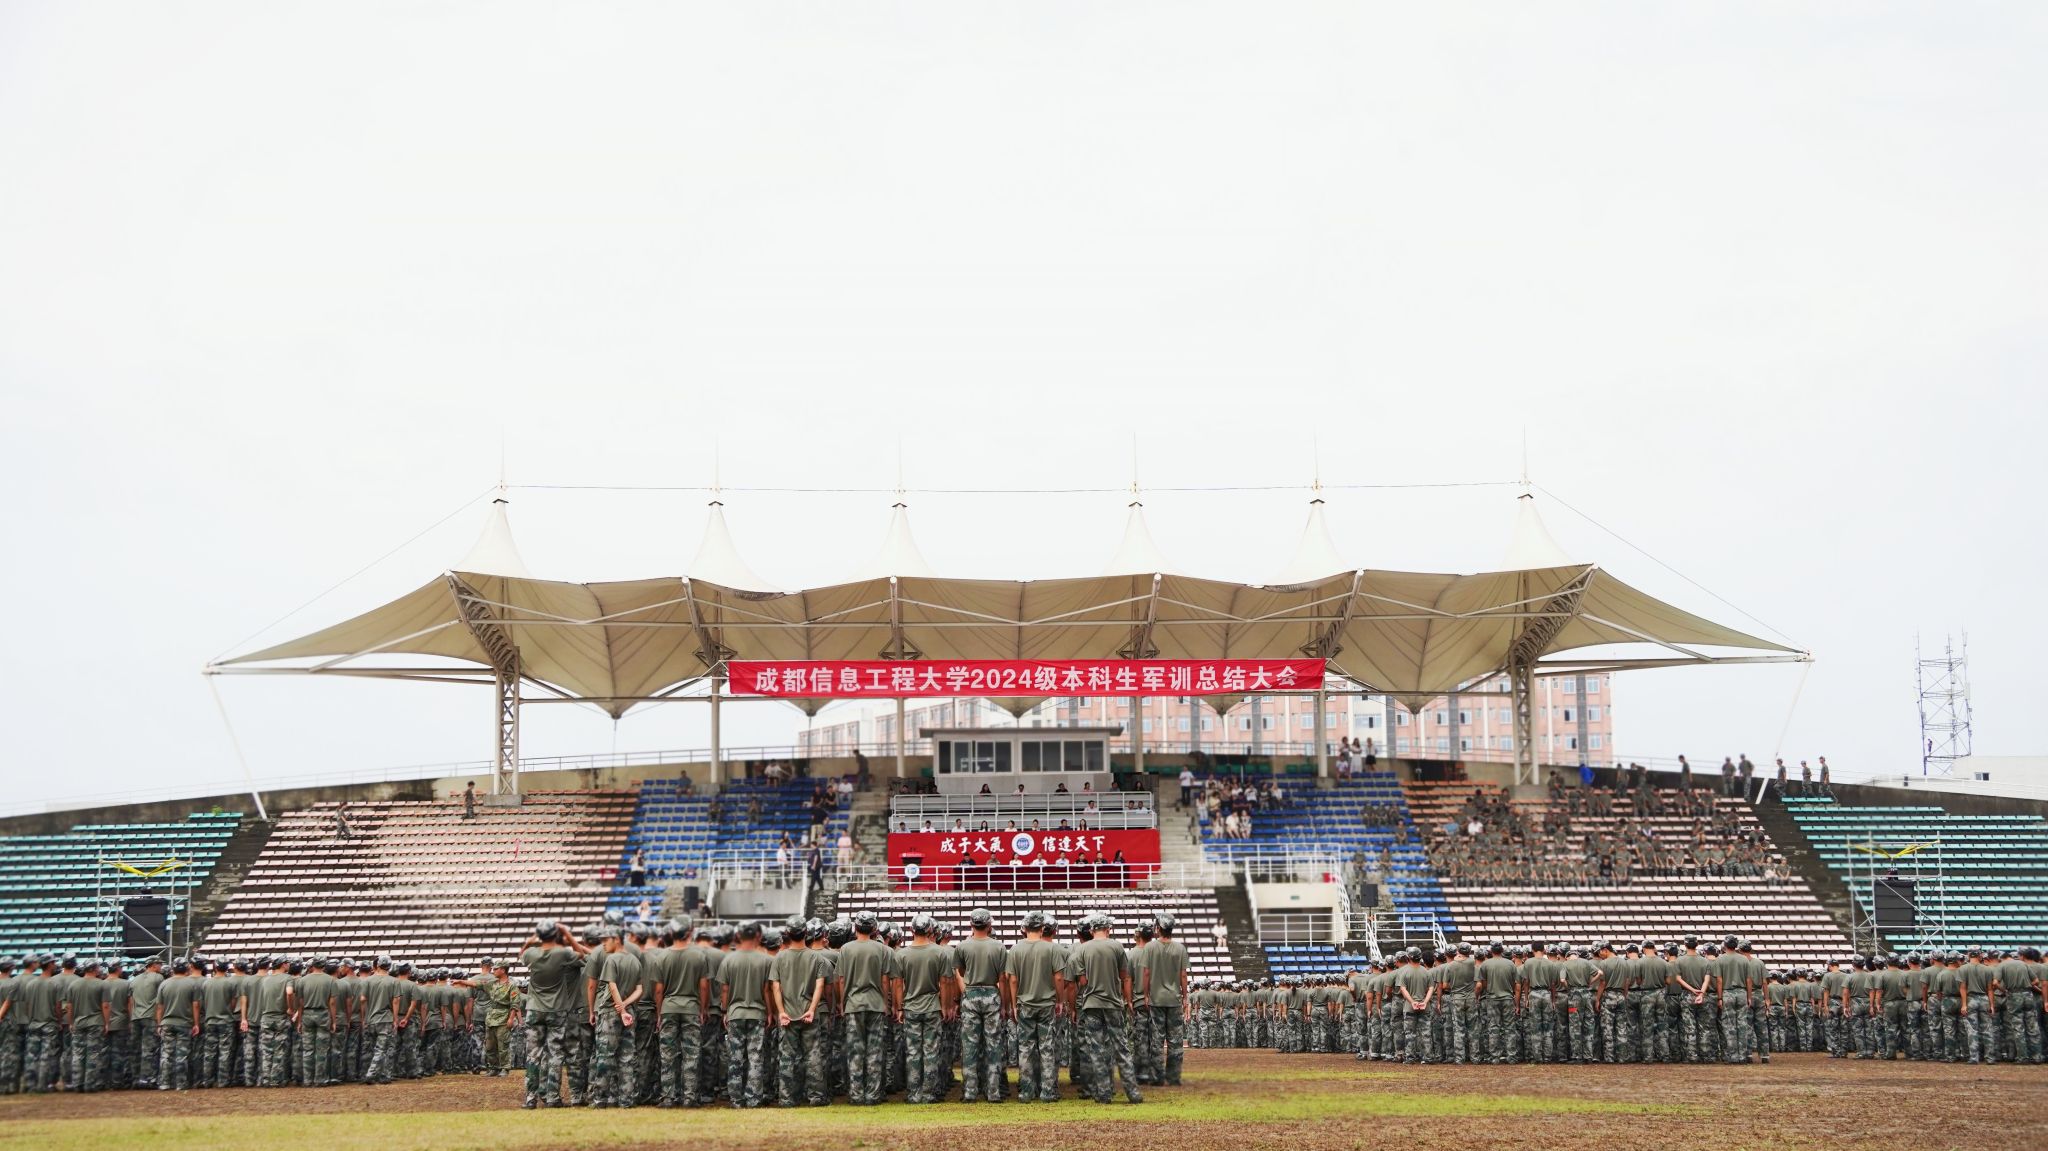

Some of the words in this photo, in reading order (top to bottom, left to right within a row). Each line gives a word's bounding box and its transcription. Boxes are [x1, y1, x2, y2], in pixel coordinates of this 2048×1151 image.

[755, 666, 1297, 692] 成都信息工程大学2024级本科生军训总结大会
